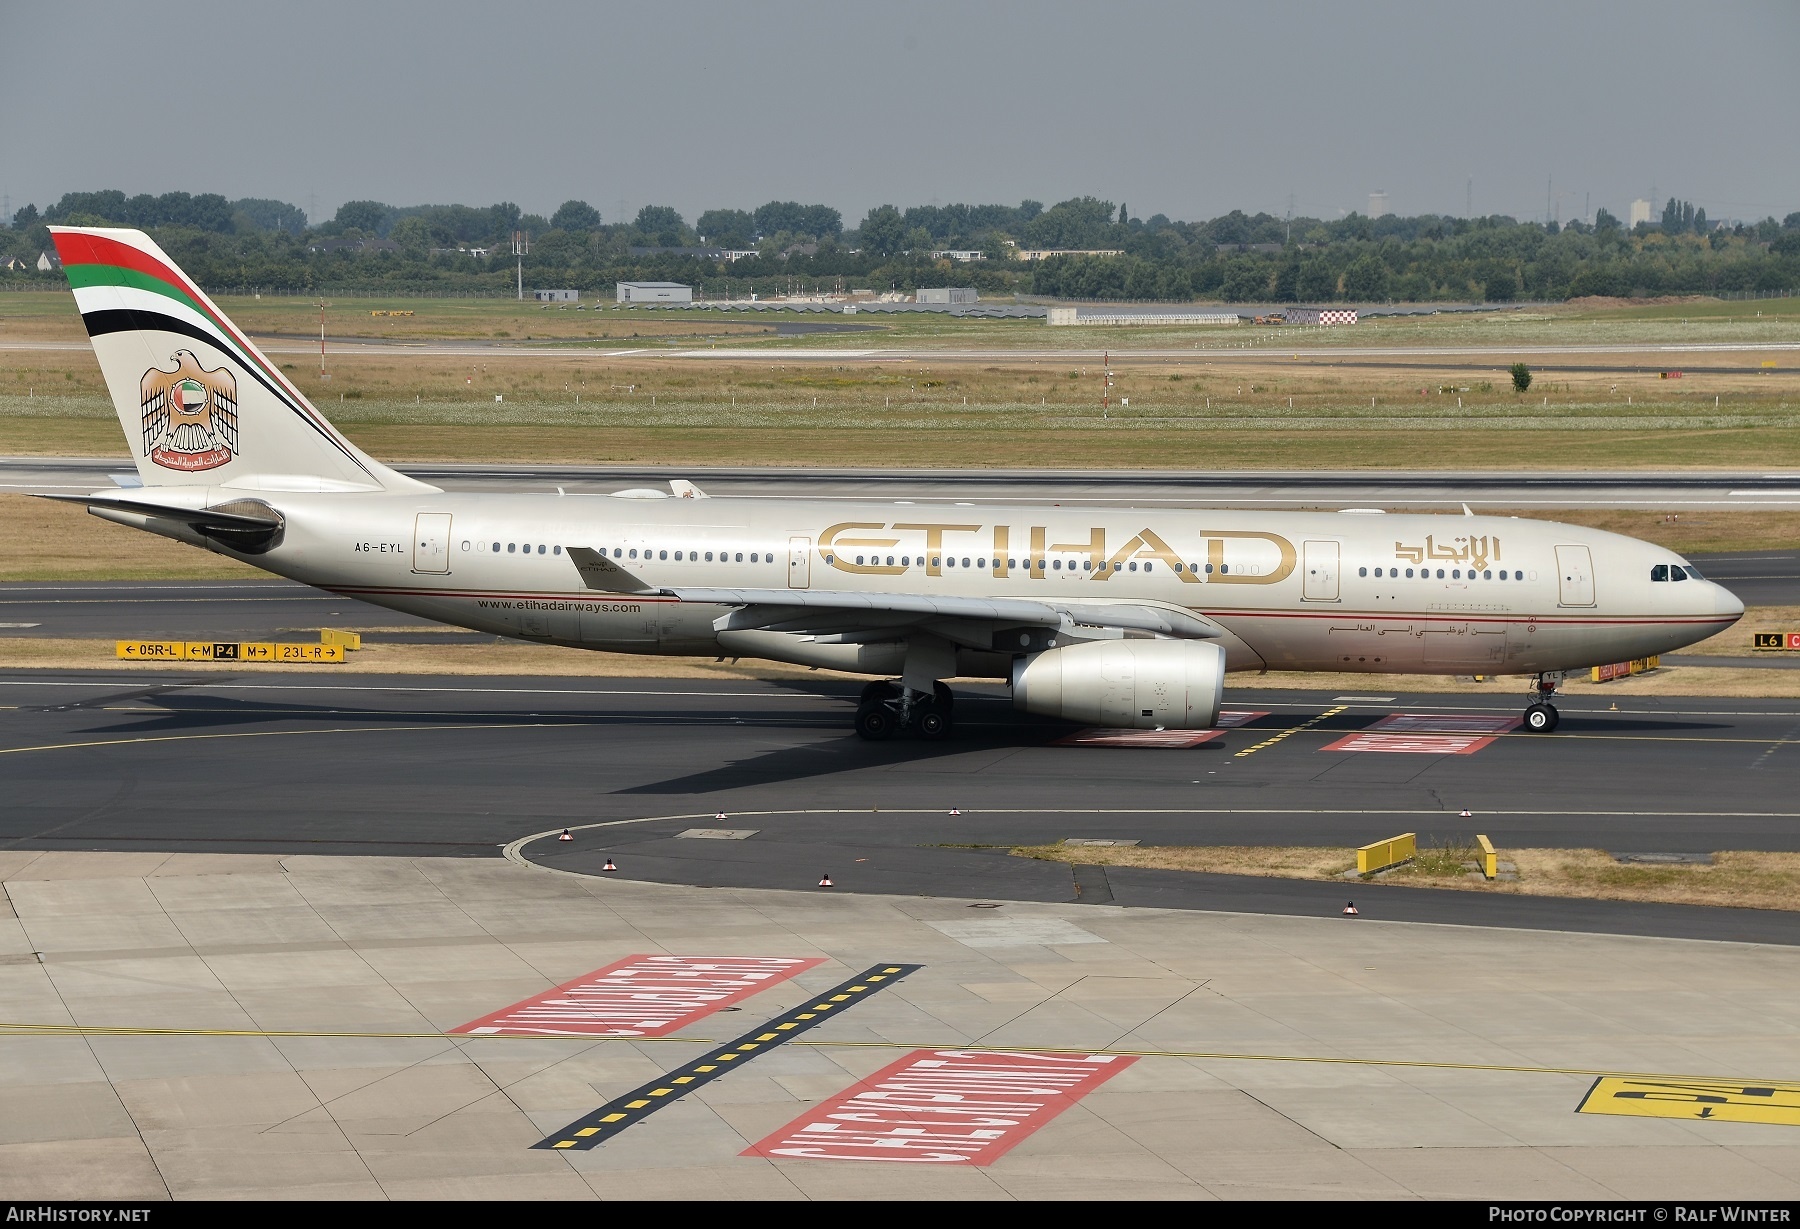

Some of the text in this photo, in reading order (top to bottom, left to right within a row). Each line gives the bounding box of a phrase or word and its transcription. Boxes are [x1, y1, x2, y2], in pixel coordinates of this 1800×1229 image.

[354, 542, 404, 553] A6-EYL
[818, 521, 1297, 585] ETIHAD
[1395, 534, 1501, 573] الاتحاد
[477, 599, 641, 614] www.etihadairways.com
[1328, 624, 1376, 636] العالم
[1471, 628, 1507, 636] من
[1760, 635, 1778, 647] L6
[139, 644, 322, 658] 05R-L M P4 M 23L-R
[769, 1060, 1098, 1162] CHECKPOINT
